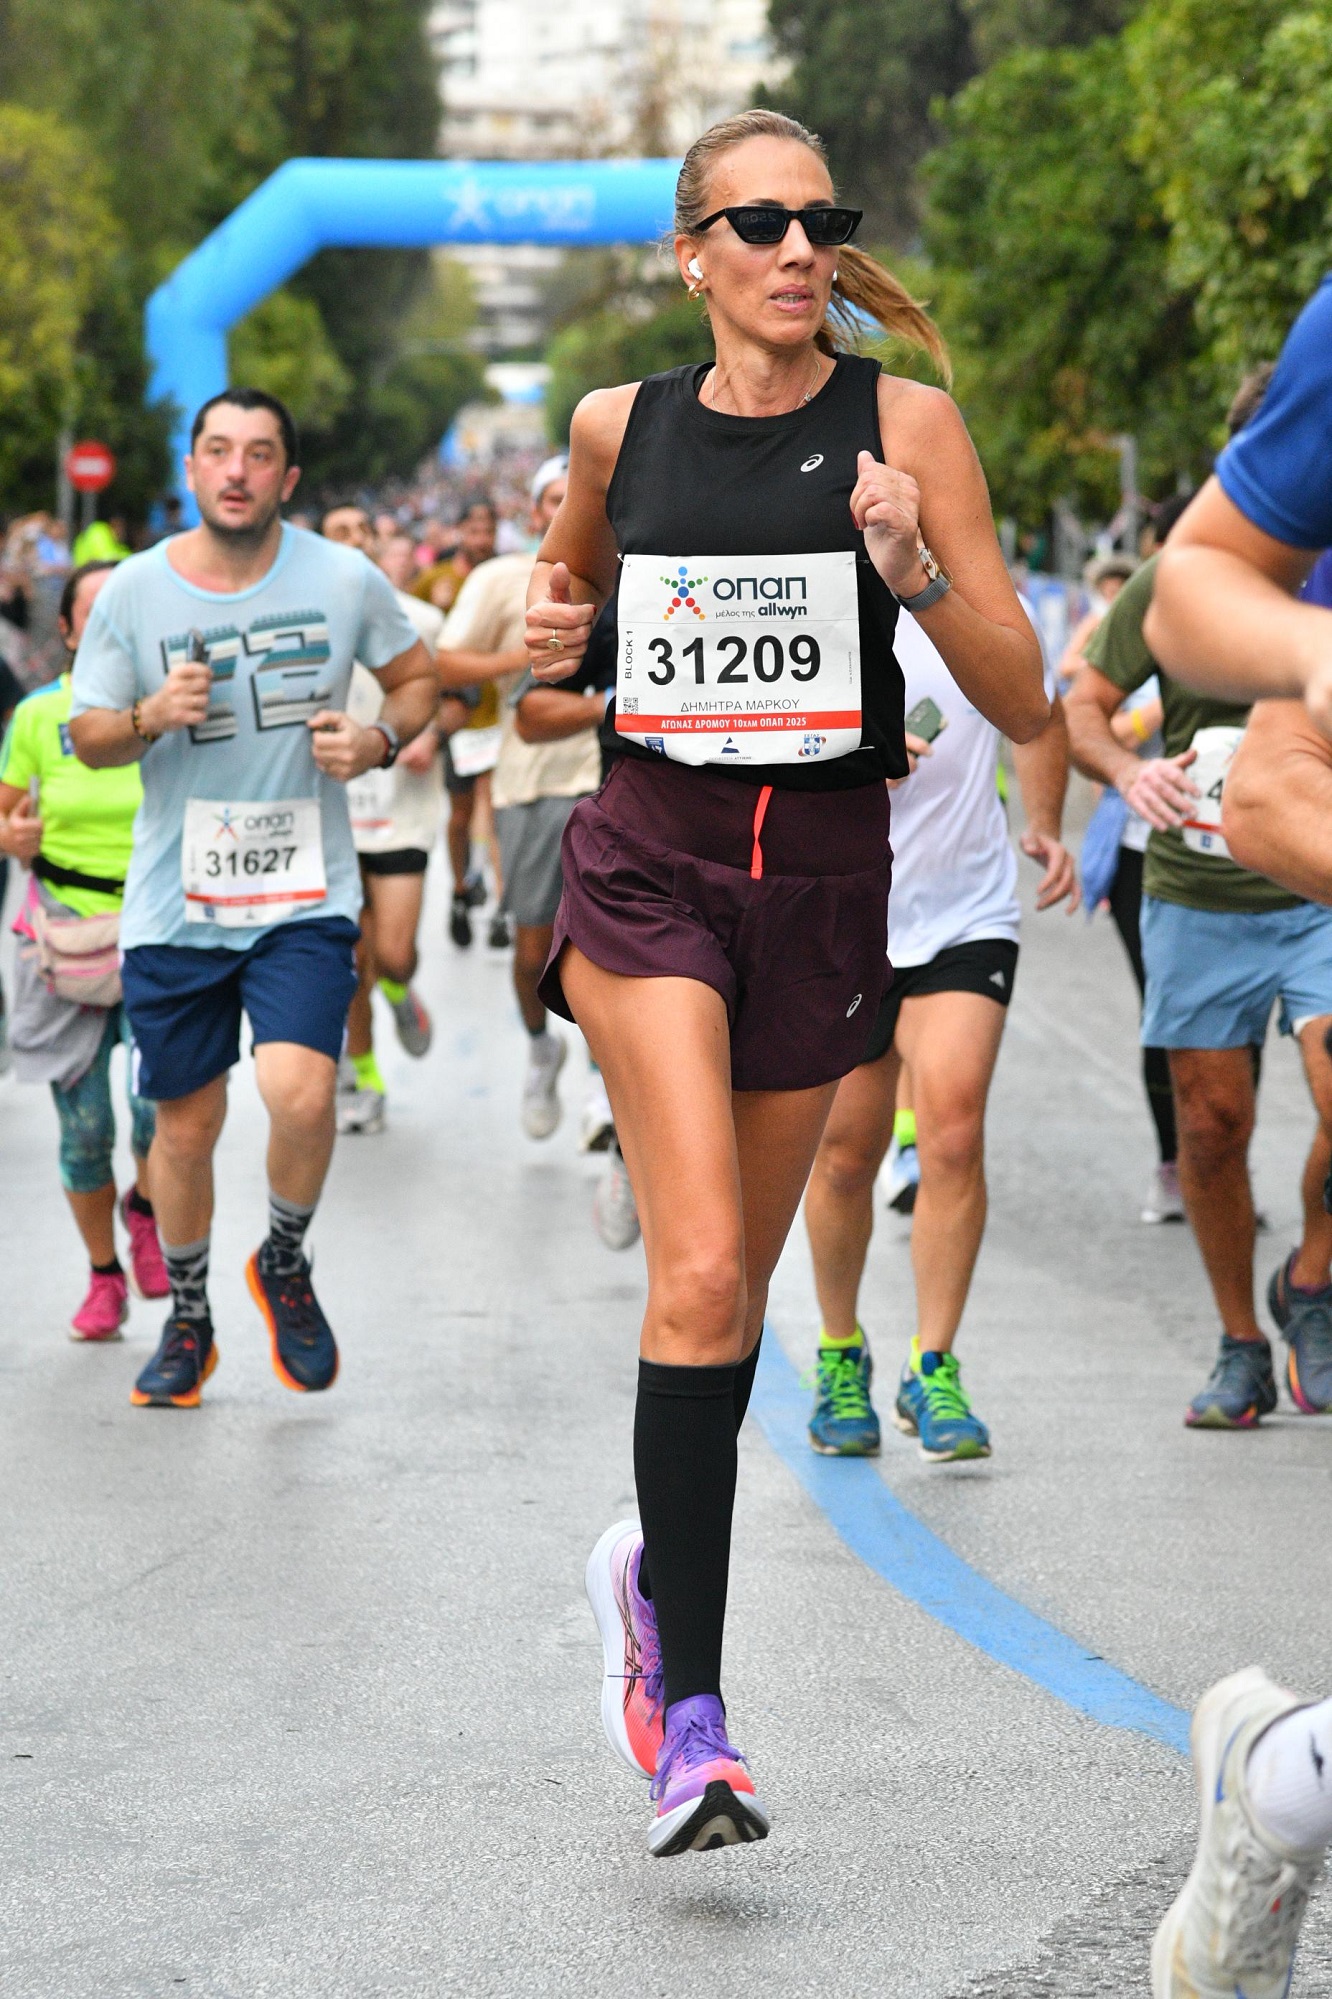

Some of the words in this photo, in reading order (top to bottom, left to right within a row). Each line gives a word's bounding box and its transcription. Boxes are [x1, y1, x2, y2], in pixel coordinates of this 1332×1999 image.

[758, 602, 807, 620] allwyn
[624, 637, 633, 679] BLOCK
[647, 634, 821, 686] 31209
[680, 701, 742, 713] ΔΗΜΗΤΡΑ
[746, 698, 800, 711] ΜΑΡΚΟΥ
[661, 720, 693, 729] ΑΓΩΝΑΣ
[695, 719, 730, 729] ΔΡΟΜΟΥ
[760, 718, 783, 727] ΟΠΑΠ
[786, 717, 807, 727] 2025
[206, 845, 298, 878] 31627
